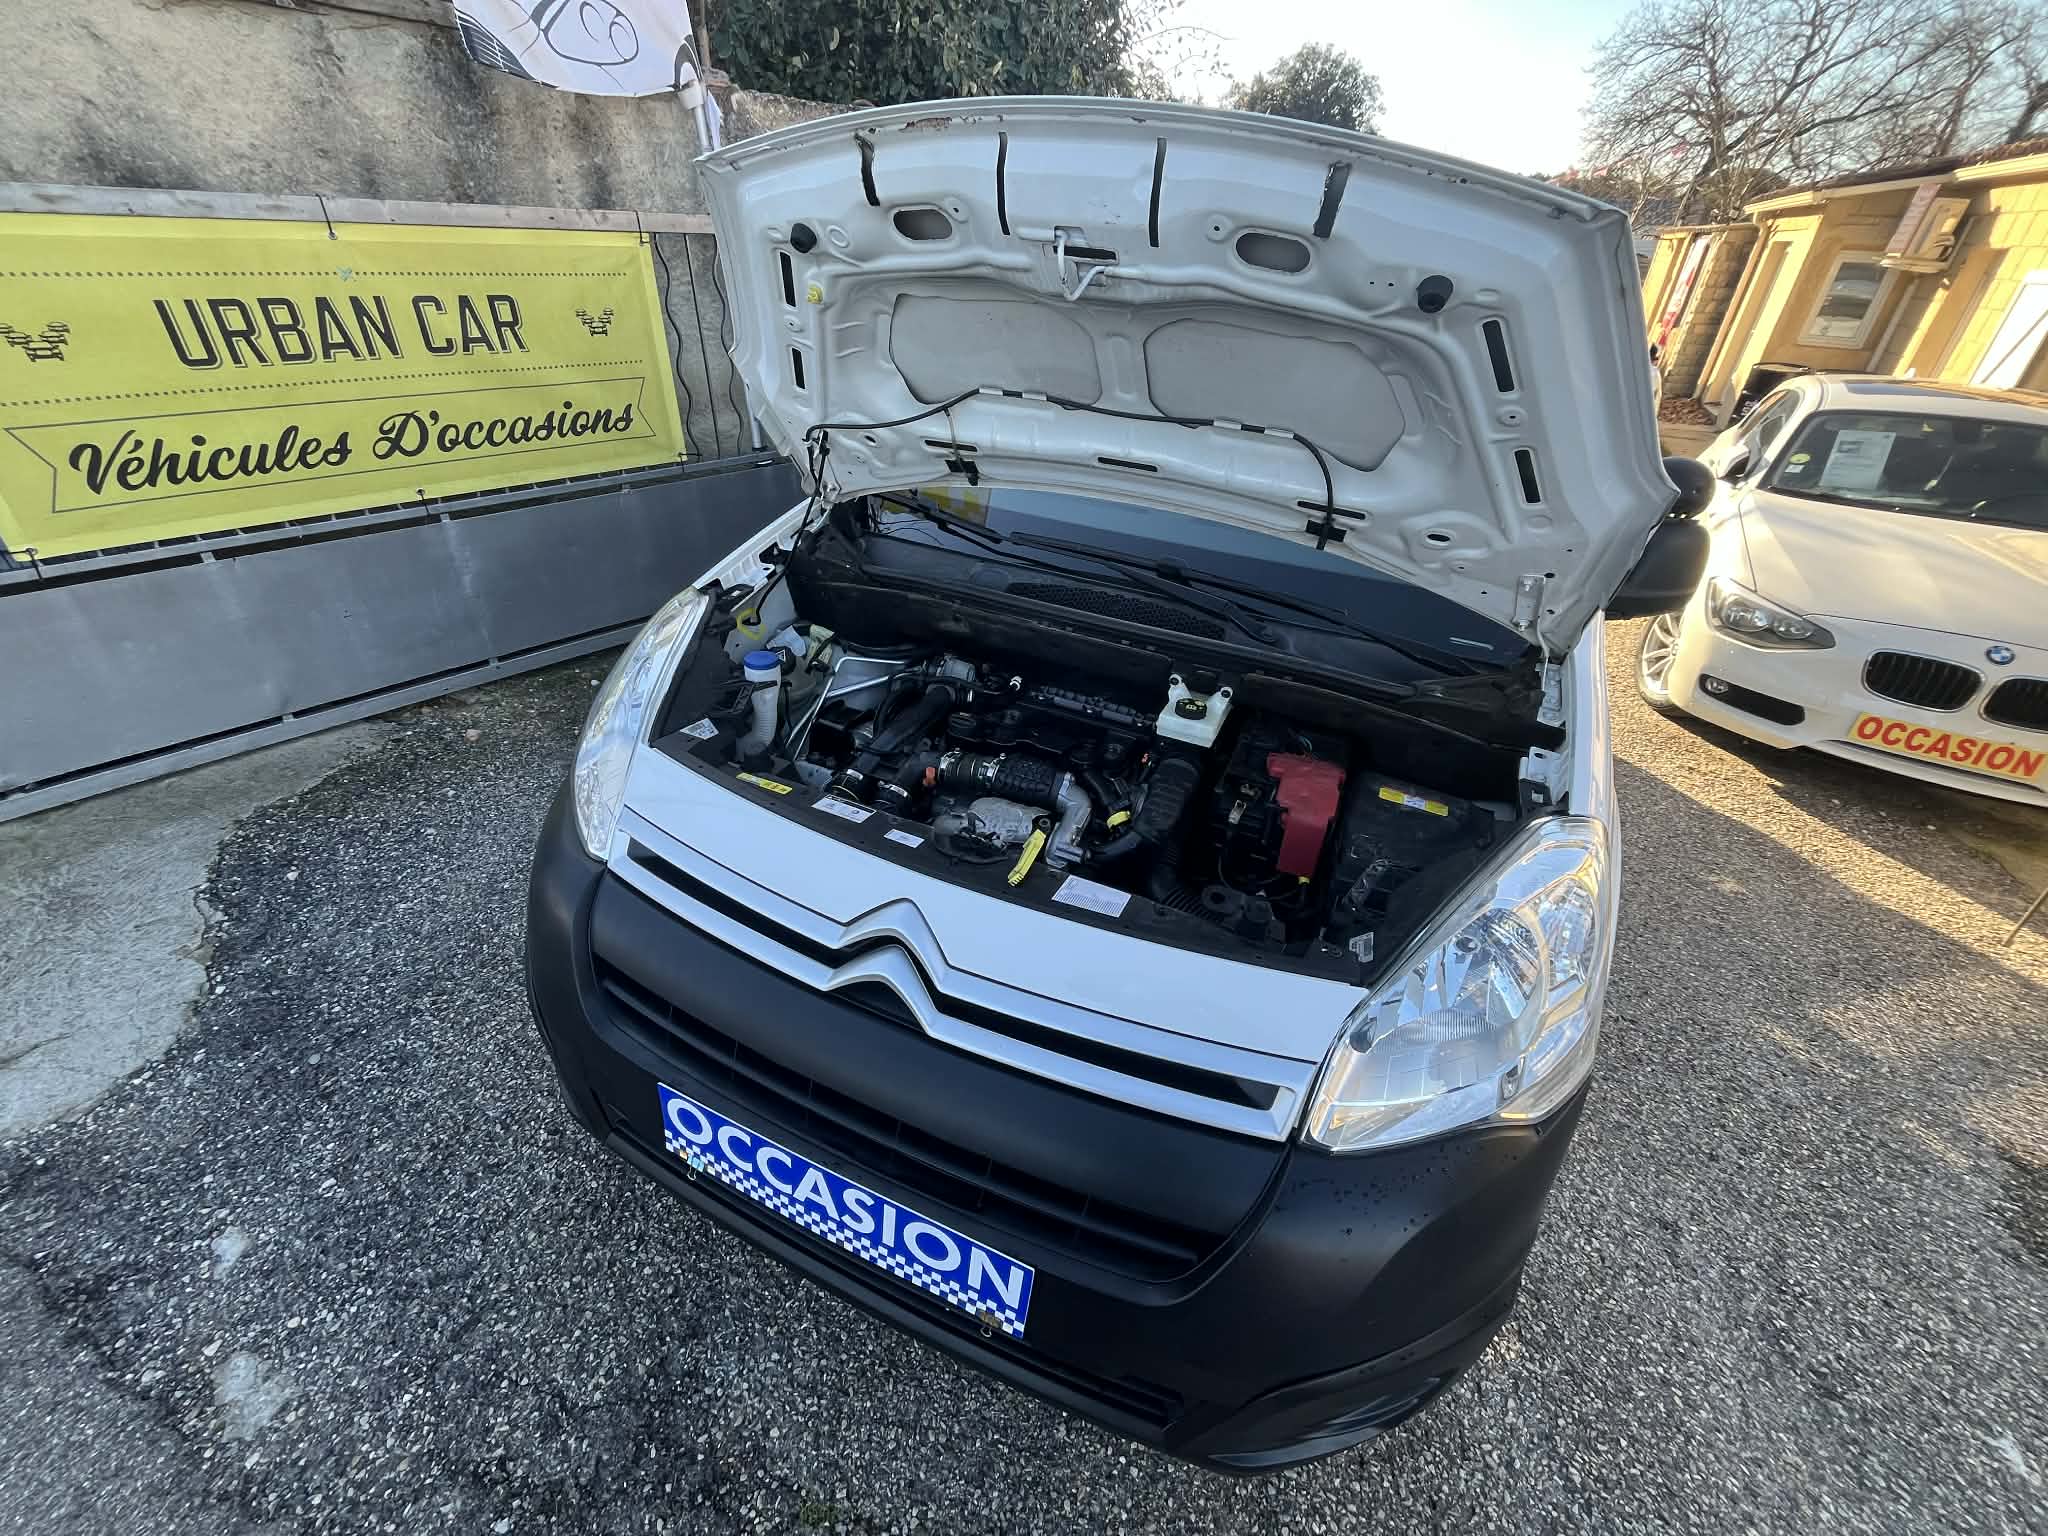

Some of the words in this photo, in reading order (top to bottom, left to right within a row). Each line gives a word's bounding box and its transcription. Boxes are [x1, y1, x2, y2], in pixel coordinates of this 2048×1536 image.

[153, 296, 404, 370] URBAN
[411, 294, 530, 355] CAR
[69, 425, 352, 495] Véhicules
[372, 401, 634, 461] D'occasions
[1857, 716, 2044, 776] OCCASION
[666, 1098, 1025, 1306] OCCASION
